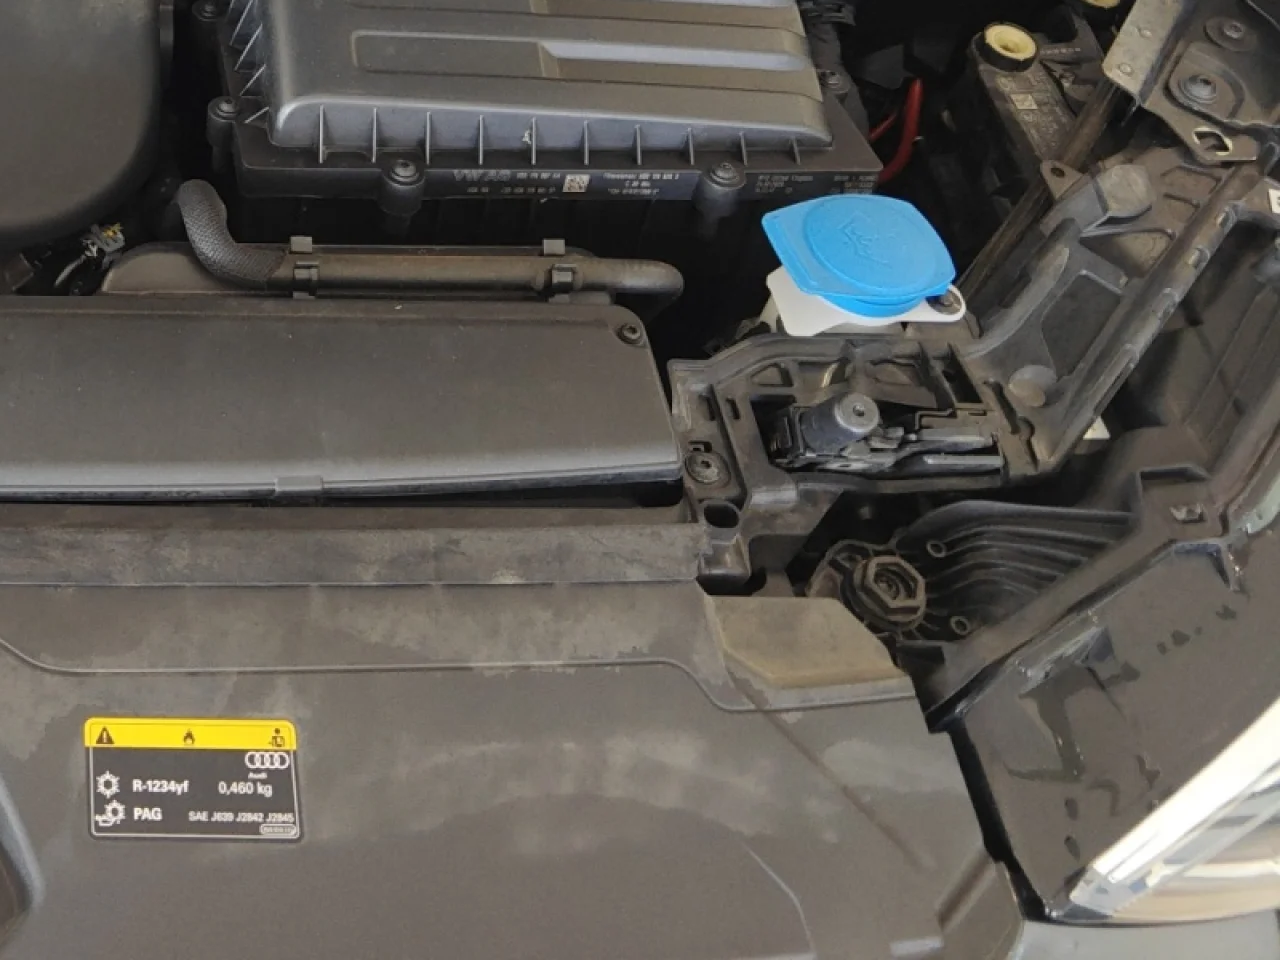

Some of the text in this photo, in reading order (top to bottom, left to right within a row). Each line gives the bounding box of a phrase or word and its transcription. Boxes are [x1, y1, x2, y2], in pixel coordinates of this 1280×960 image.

[132, 779, 273, 798] R-1234yf 0,460 kg
[133, 807, 163, 821] PAG
[188, 811, 209, 822] SAE
